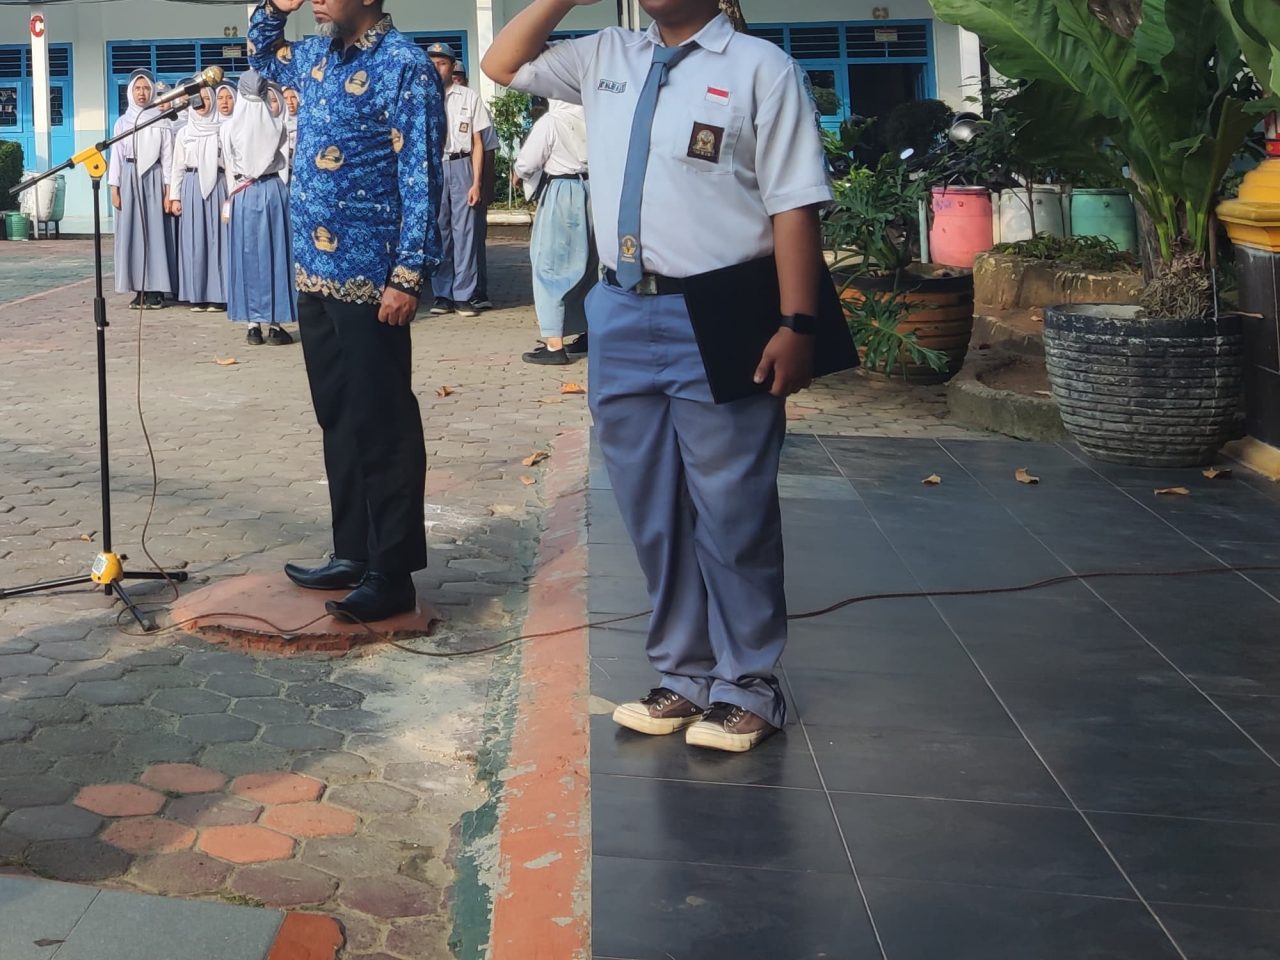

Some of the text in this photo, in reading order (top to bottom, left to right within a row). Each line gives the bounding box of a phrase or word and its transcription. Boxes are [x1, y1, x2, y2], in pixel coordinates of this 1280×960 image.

[872, 7, 889, 19] C3
[30, 15, 44, 37] C
[223, 26, 238, 37] C2
